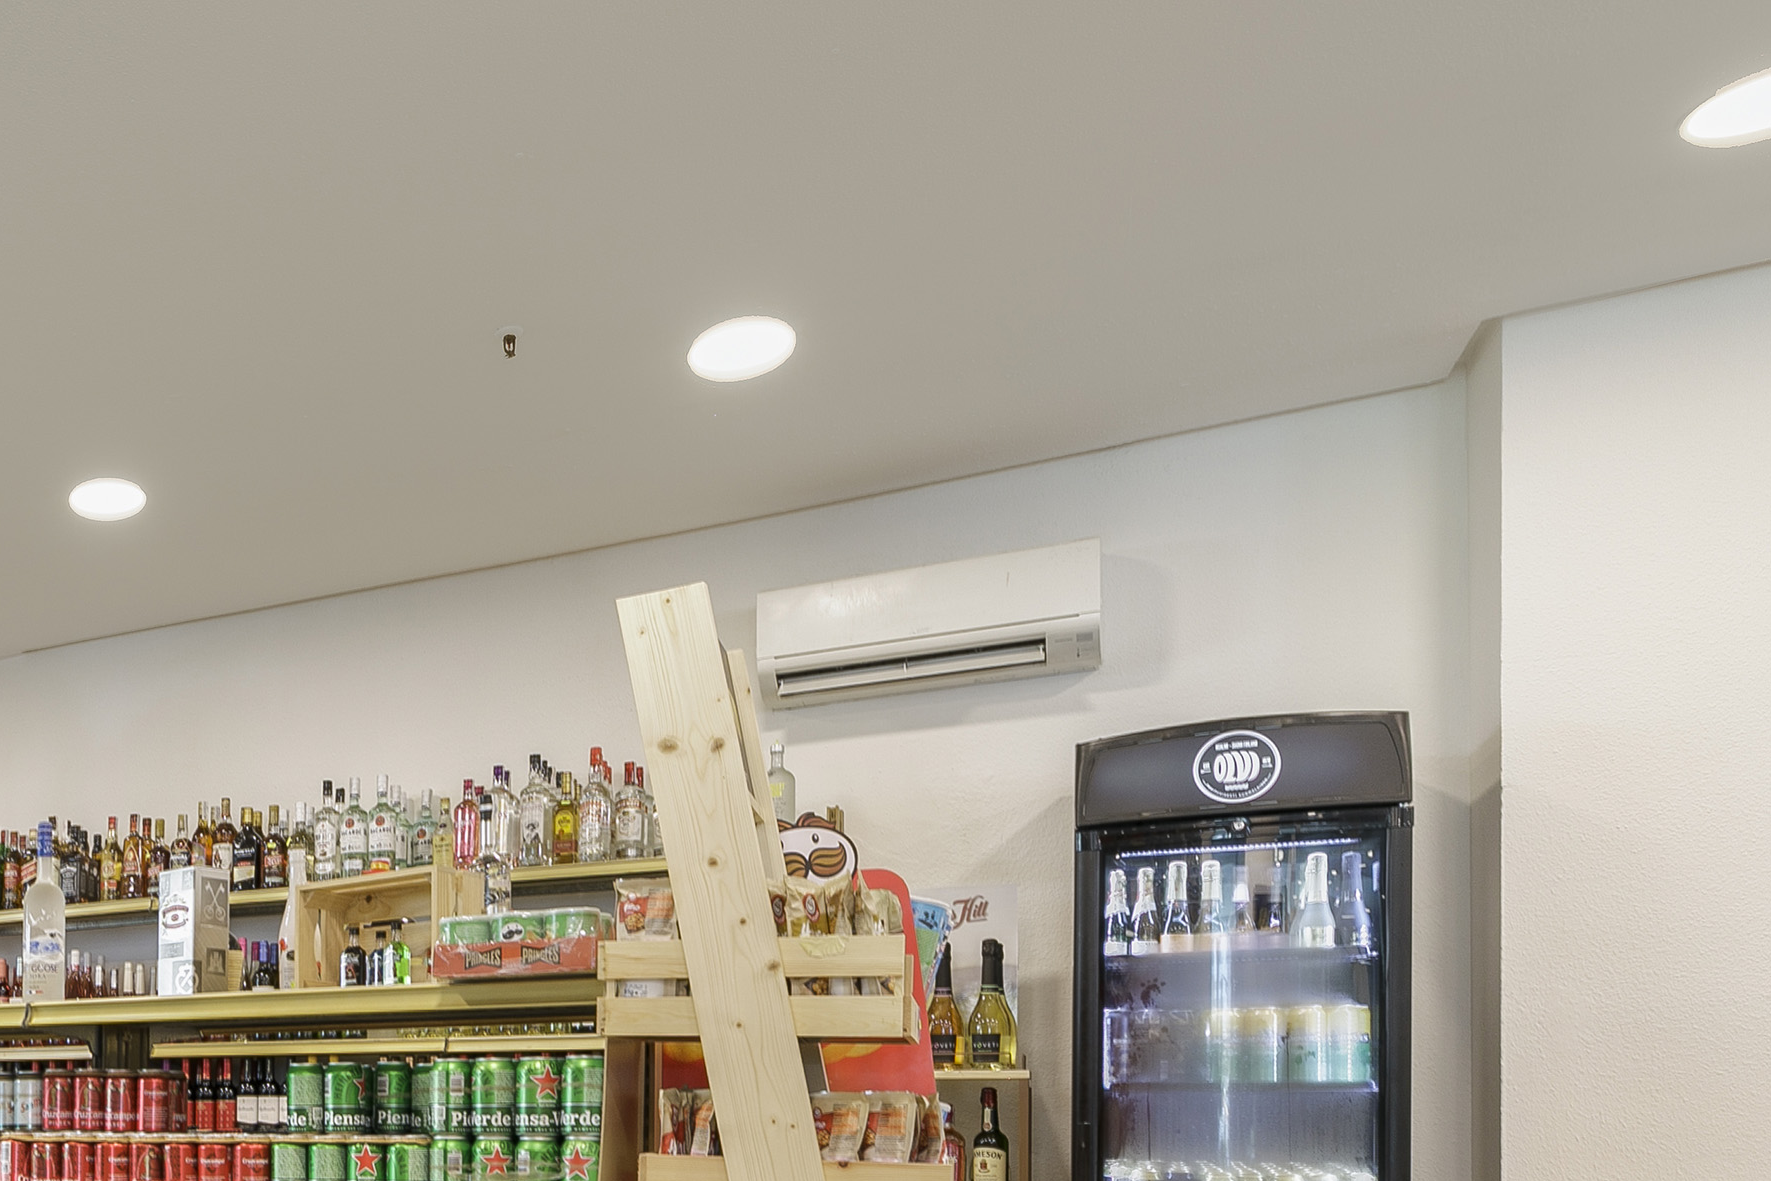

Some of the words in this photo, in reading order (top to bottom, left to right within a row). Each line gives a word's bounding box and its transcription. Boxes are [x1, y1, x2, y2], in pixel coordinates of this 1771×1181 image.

[465, 948, 501, 969] PRINGLES
[521, 944, 560, 965] PRINGLES
[974, 1151, 1003, 1160] AMESON
